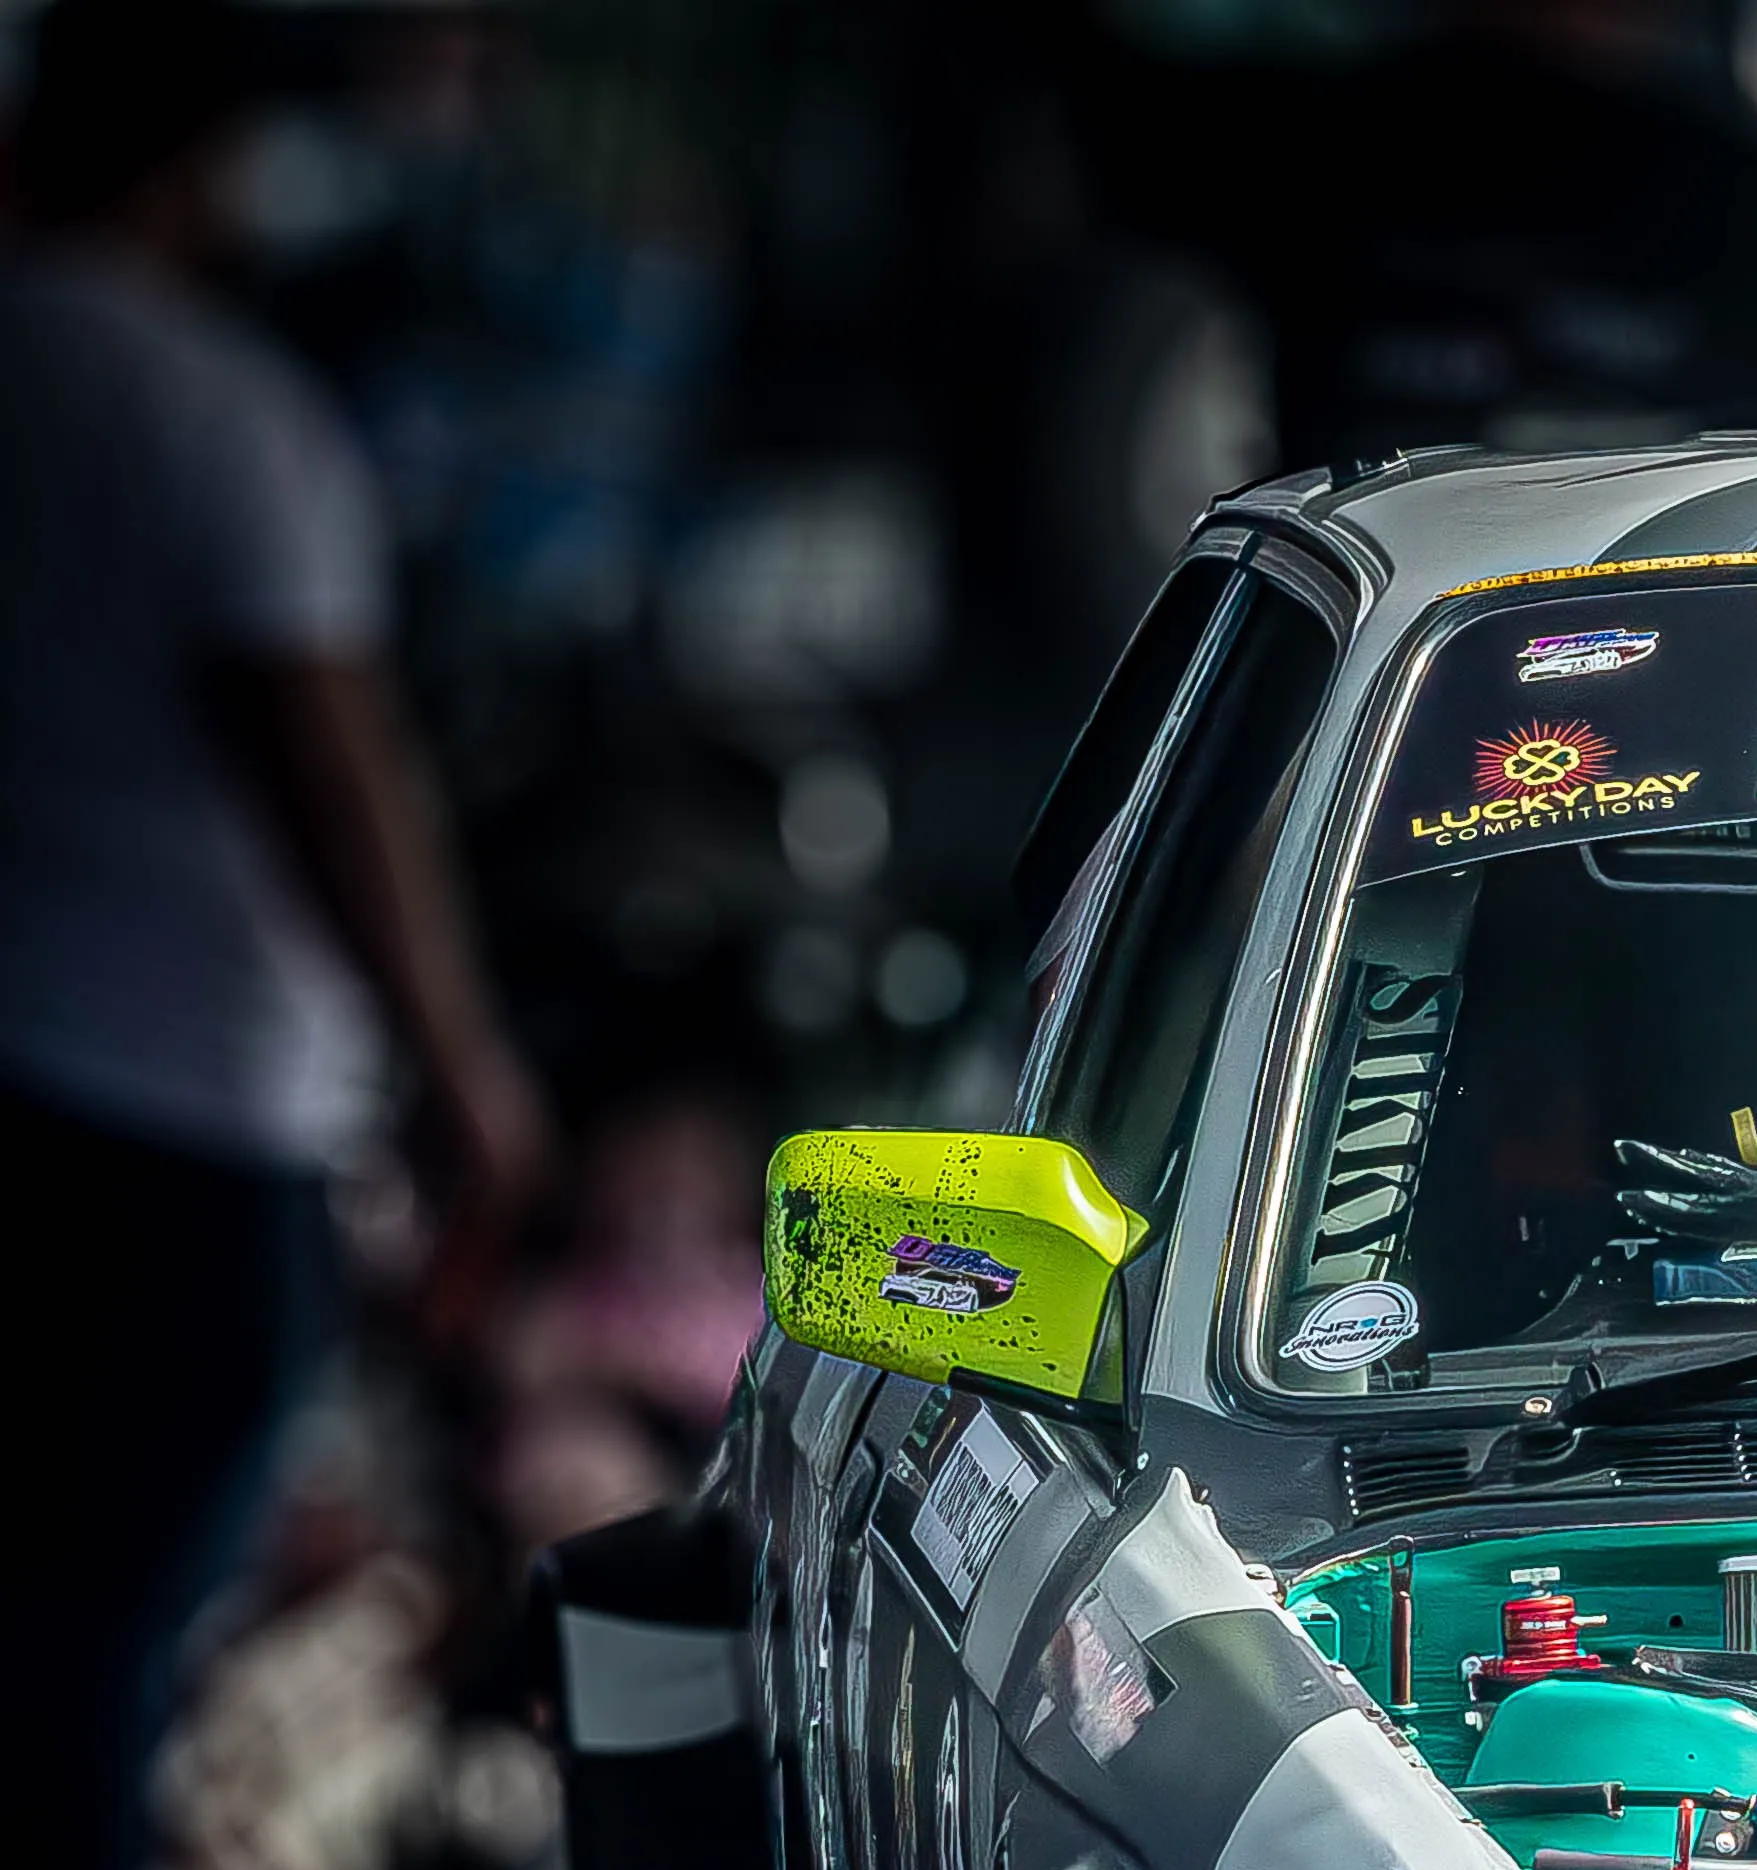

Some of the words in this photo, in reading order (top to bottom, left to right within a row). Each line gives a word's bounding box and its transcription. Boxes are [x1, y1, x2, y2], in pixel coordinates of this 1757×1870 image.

[1411, 786, 1587, 838] LUCKY
[1595, 771, 1701, 803] DAY
[1435, 795, 1677, 847] COMPETITIONS
[1312, 972, 1461, 1266] SIKKY
